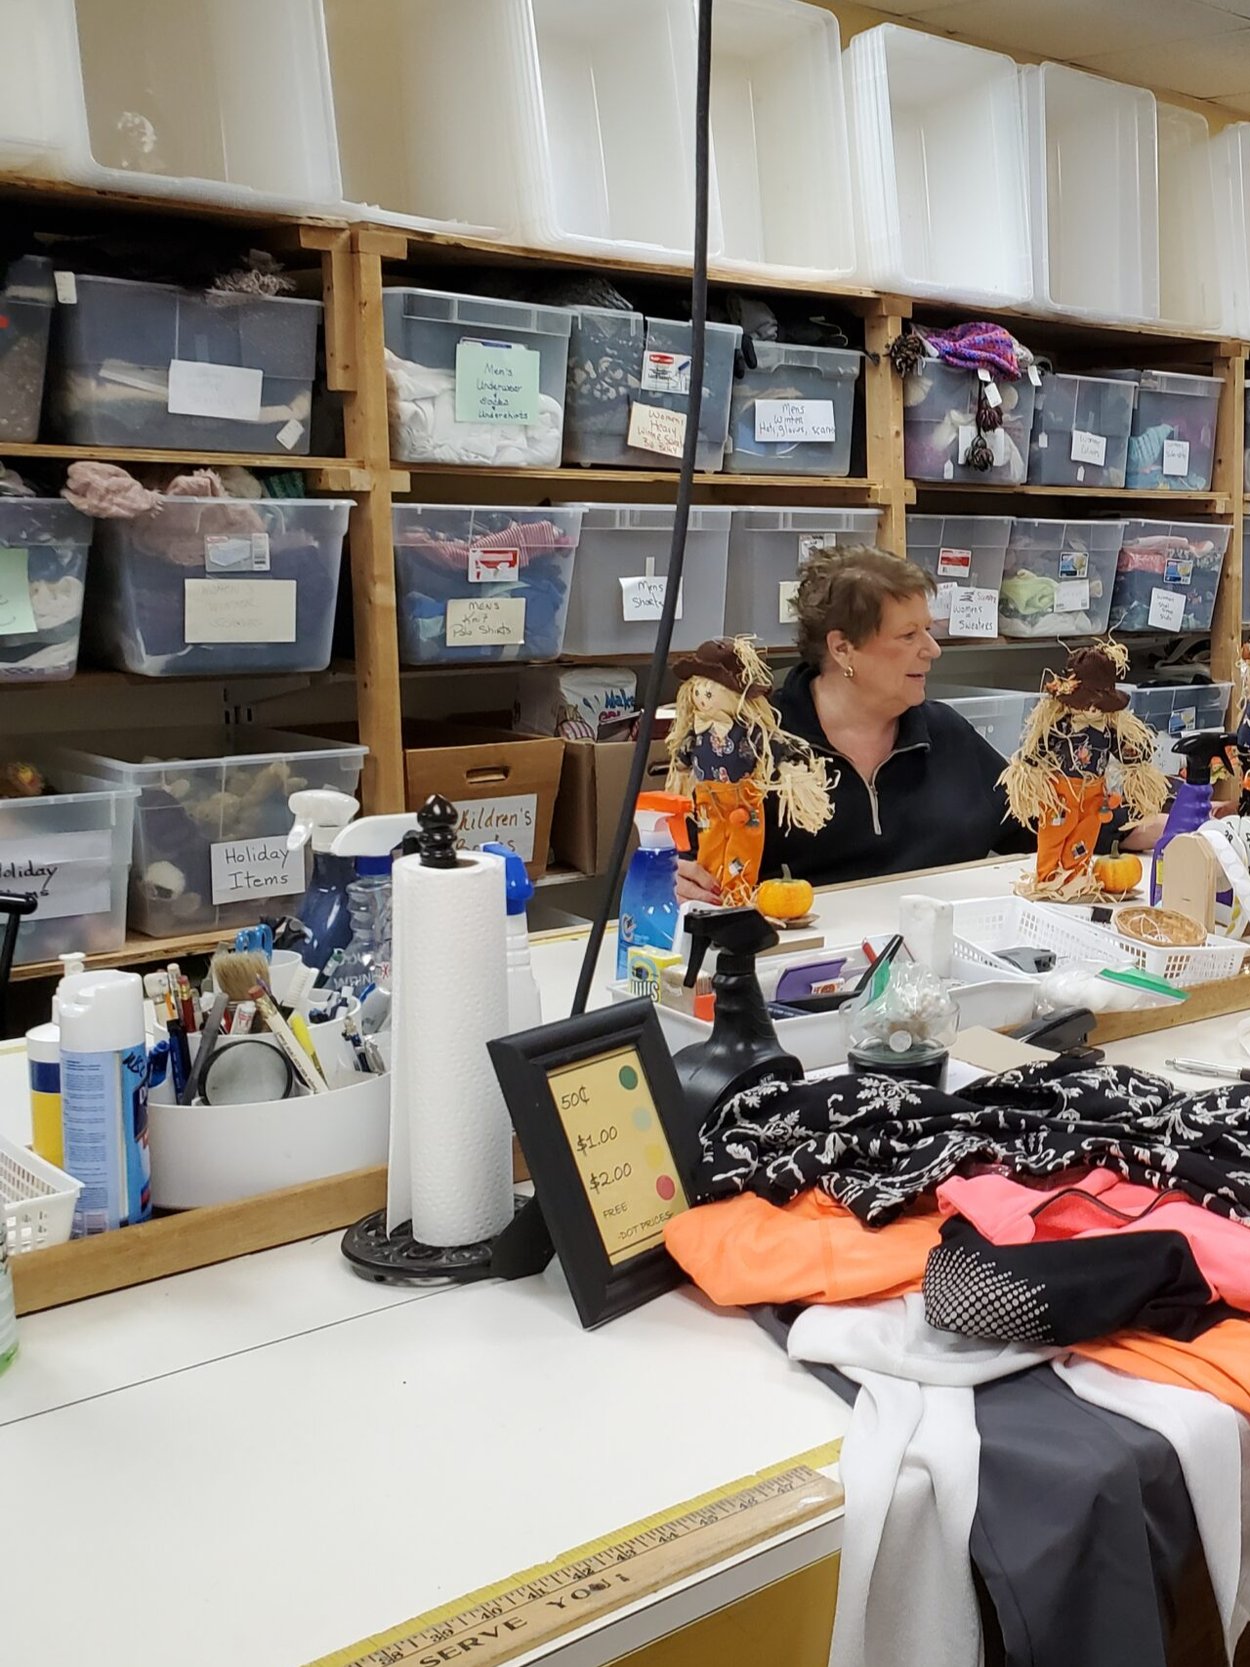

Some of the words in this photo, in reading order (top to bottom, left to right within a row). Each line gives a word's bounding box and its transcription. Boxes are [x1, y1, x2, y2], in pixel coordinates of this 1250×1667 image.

[457, 807, 532, 832] hildren's
[225, 843, 290, 869] Holiday
[0, 859, 58, 890] oliday
[228, 871, 289, 890] Items
[561, 1084, 591, 1110] 50¢
[576, 1125, 618, 1157] $1.00
[589, 1161, 633, 1195] $2.00
[602, 1201, 628, 1219] FREE
[481, 1606, 503, 1621] 40
[571, 1566, 596, 1582] 42
[616, 1548, 637, 1562] 43
[419, 1616, 528, 1667] SERVE
